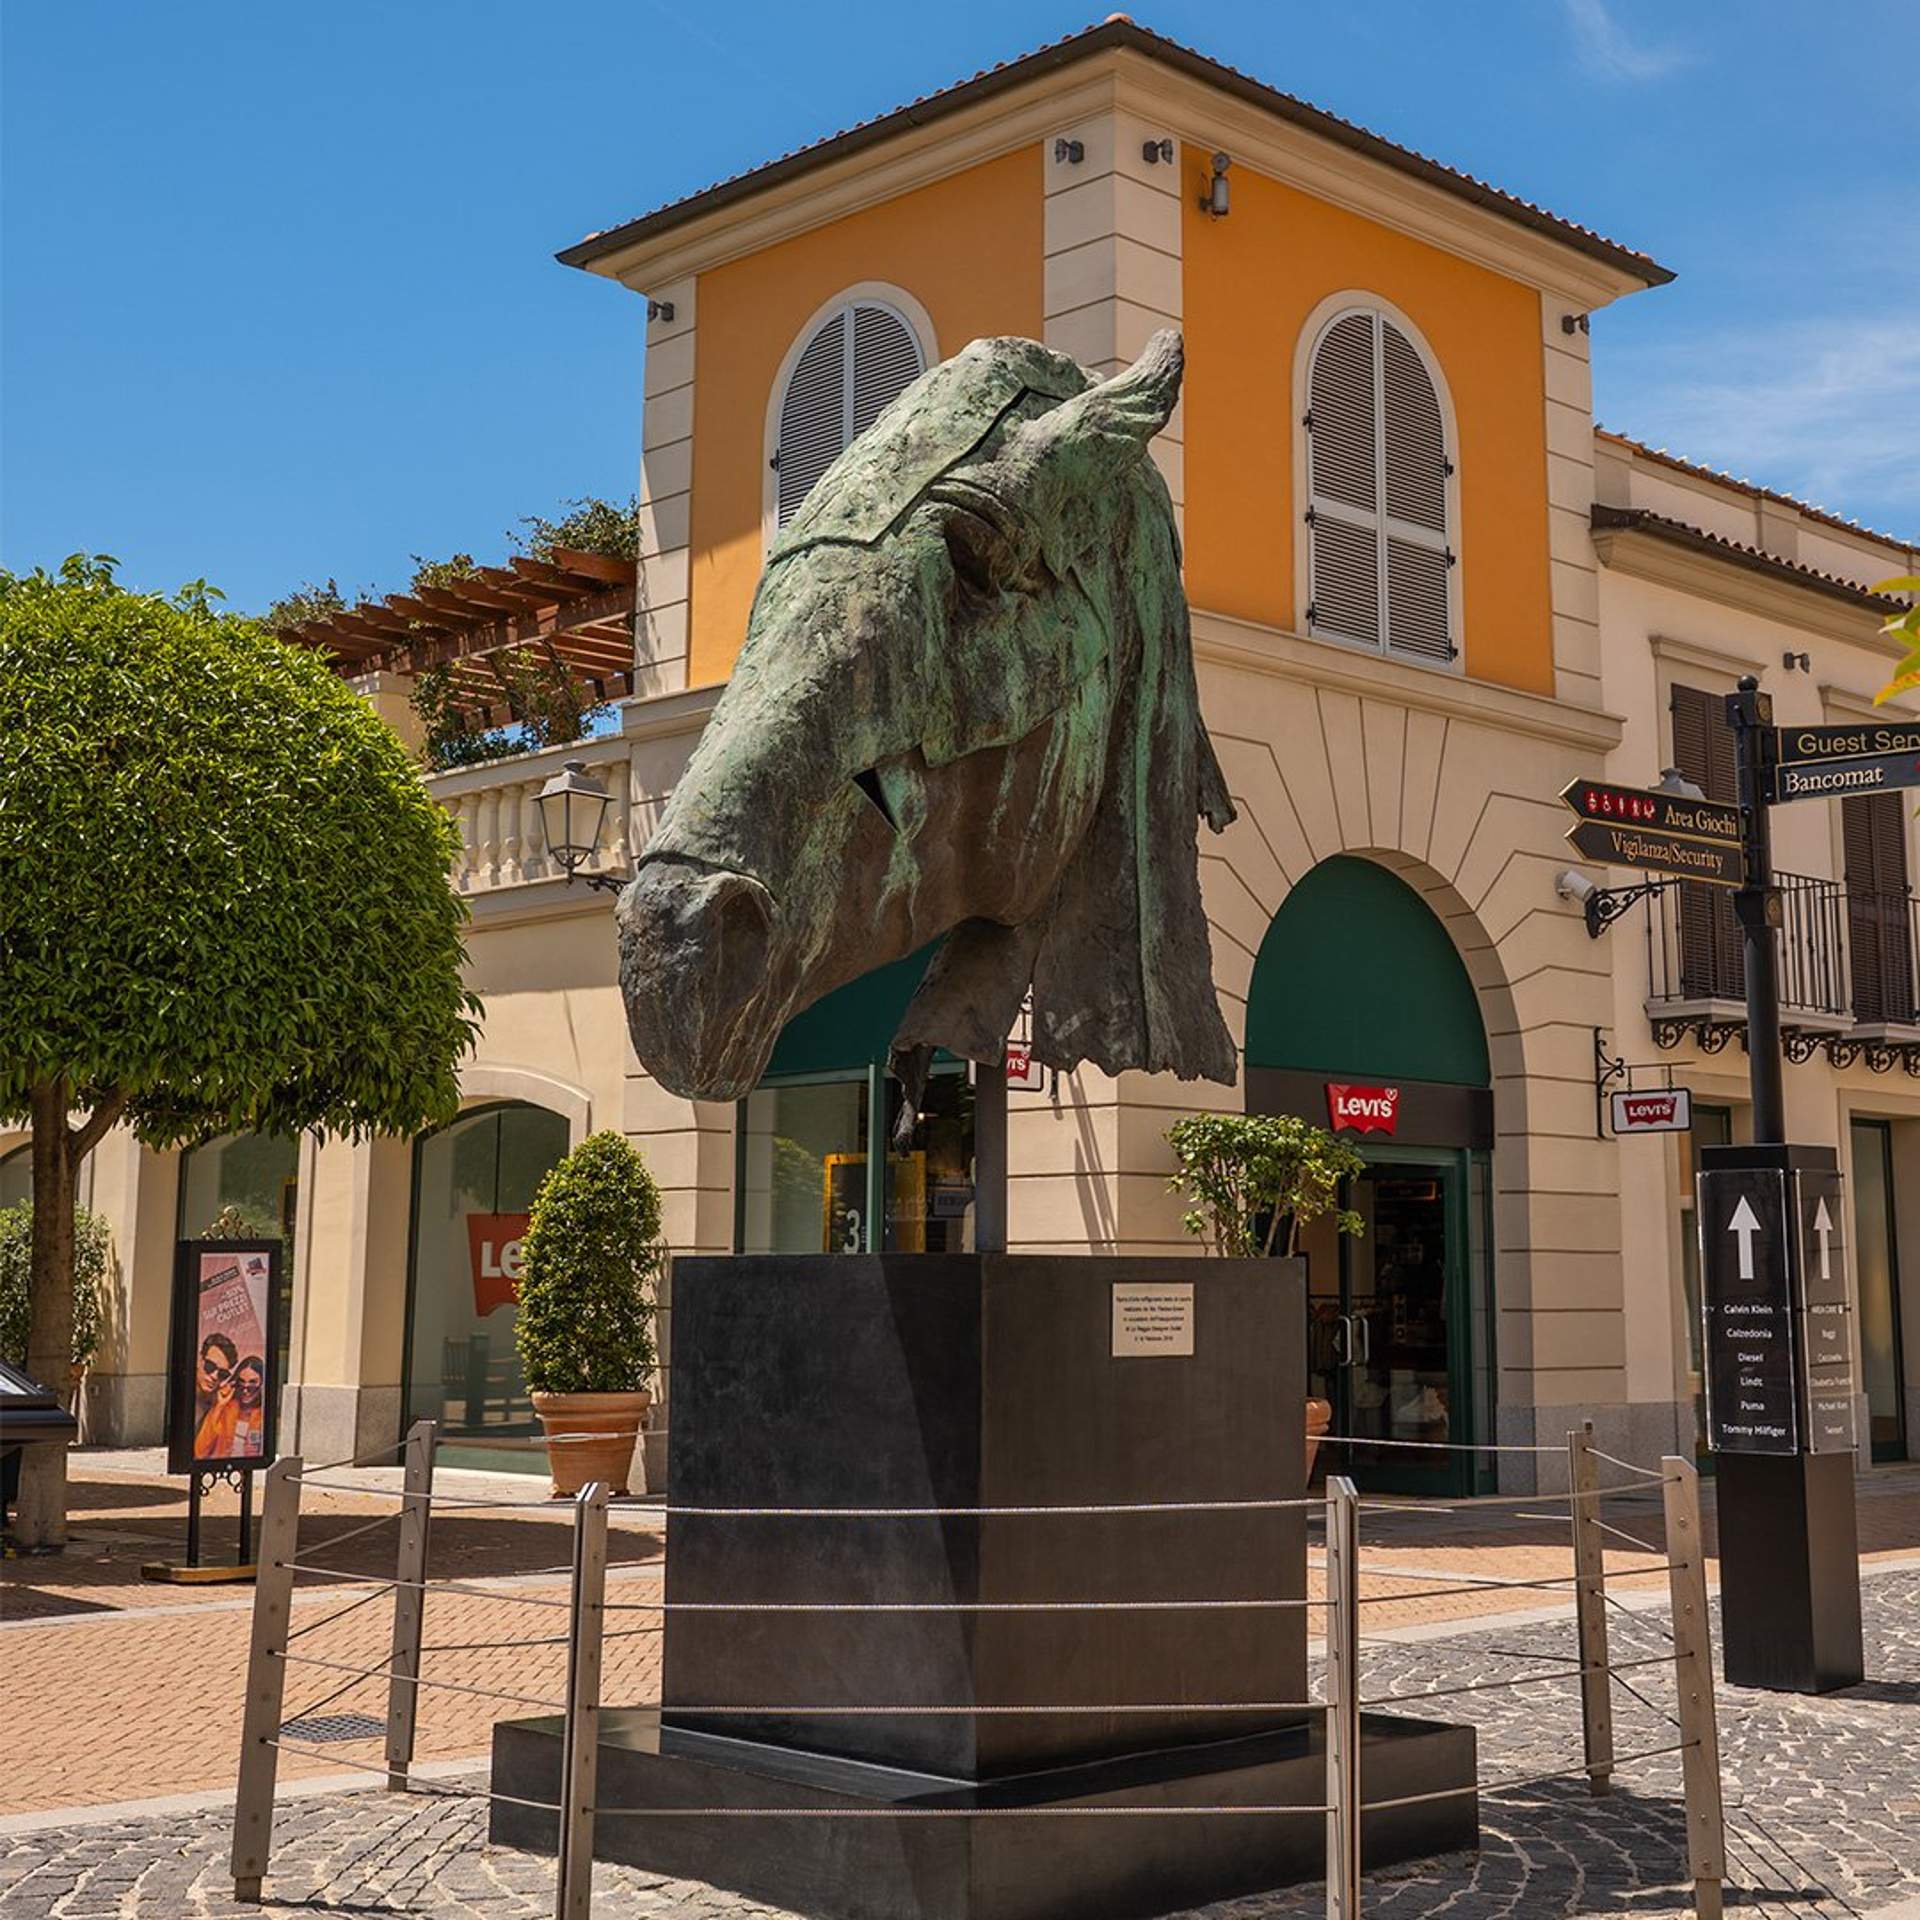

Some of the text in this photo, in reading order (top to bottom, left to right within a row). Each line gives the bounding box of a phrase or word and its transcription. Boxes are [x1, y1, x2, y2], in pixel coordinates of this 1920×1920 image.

[1797, 732, 1868, 754] Guest
[1784, 767, 1884, 793] Bancomat
[1665, 804, 1738, 836] Area Giochi
[481, 1240, 528, 1280] Le
[1723, 1304, 1773, 1315] Calvin Klein
[1725, 1328, 1772, 1339] Calzedonia
[1737, 1352, 1764, 1363] Diesel
[1740, 1376, 1764, 1387] Lindt
[1740, 1400, 1765, 1411] Puma
[1721, 1423, 1787, 1438] Tommy Hilfiger
